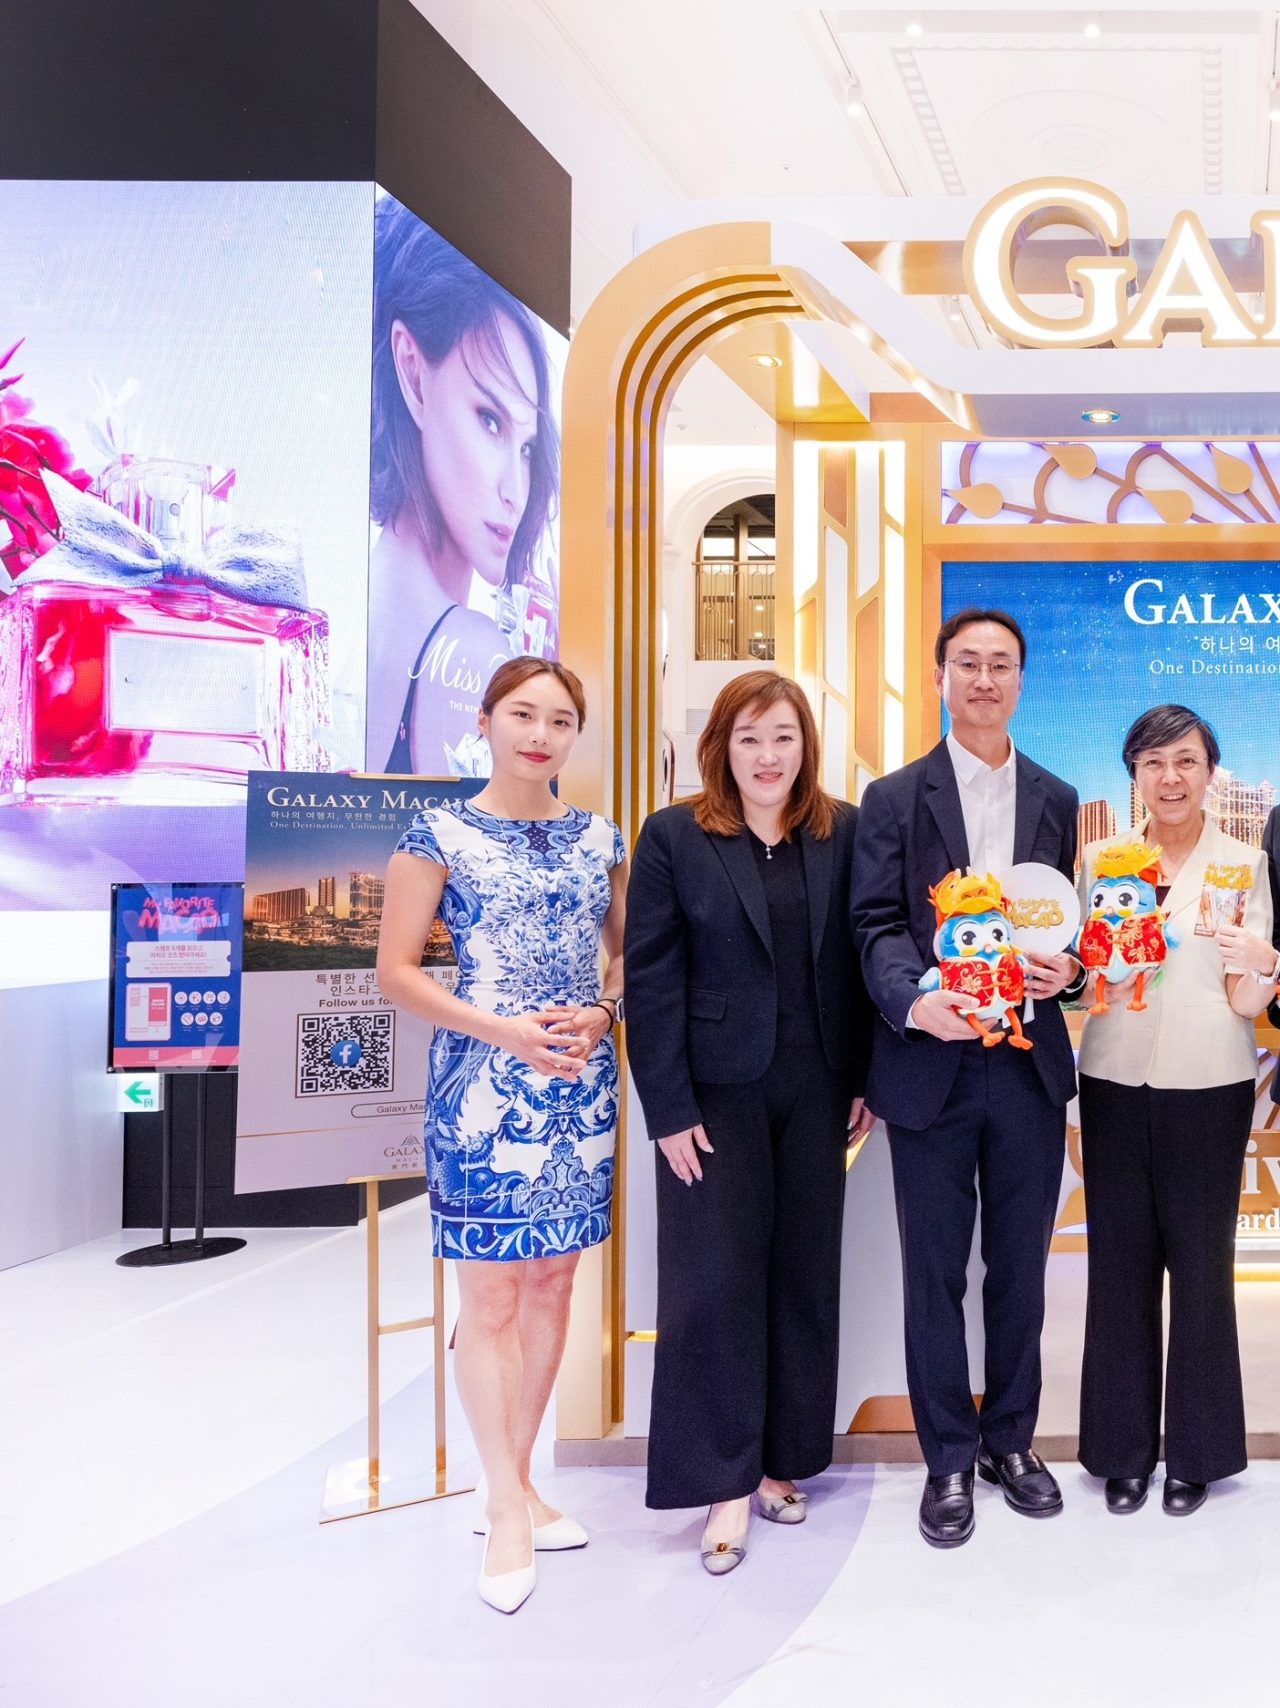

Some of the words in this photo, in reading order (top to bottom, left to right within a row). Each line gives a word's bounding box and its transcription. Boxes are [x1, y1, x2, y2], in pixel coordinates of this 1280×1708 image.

[1200, 635, 1254, 654] 하나의
[408, 635, 481, 694] Miss
[1149, 659, 1185, 674] One
[449, 700, 463, 712] THE
[267, 786, 373, 808] GALAXY
[271, 811, 300, 820] 하나의
[270, 821, 289, 829] One
[351, 822, 394, 830] Unlimited
[315, 973, 356, 985] 특별한
[319, 999, 357, 1008] Follow
[379, 997, 393, 1006] fo
[377, 1104, 407, 1114] Galaxy
[383, 1146, 424, 1158] GALA
